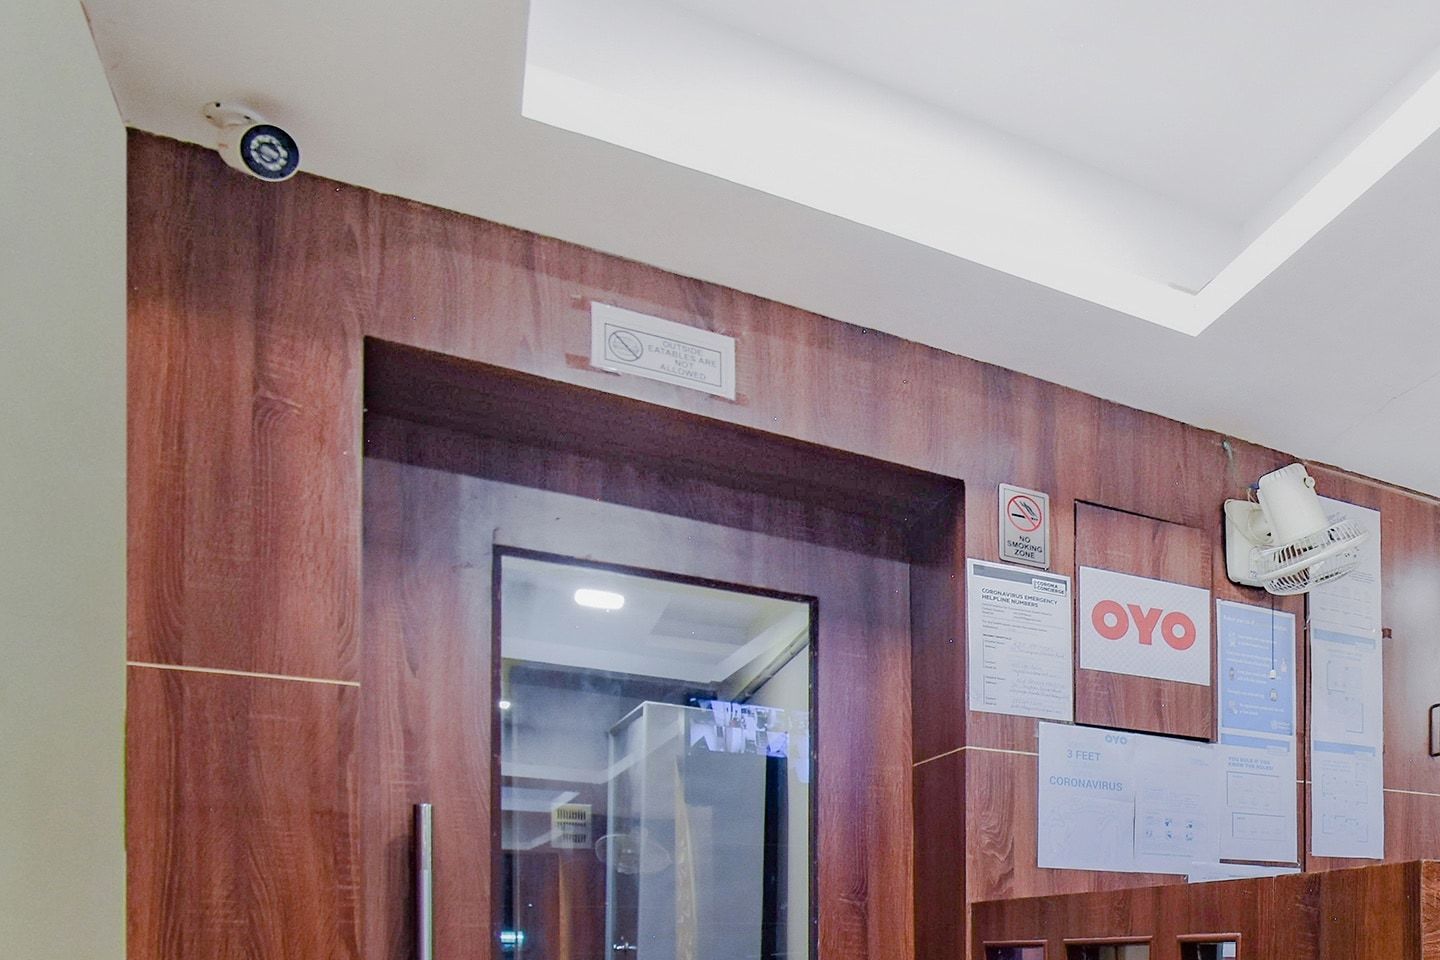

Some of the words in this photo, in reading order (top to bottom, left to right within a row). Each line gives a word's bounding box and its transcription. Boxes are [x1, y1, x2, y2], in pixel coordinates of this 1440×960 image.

[647, 344, 697, 362] EATABLES
[698, 357, 717, 368] ARE
[674, 359, 694, 369] NOT
[660, 363, 706, 380] ALLOWED
[1019, 535, 1031, 544] NO
[1007, 540, 1043, 553] SMOKING
[1014, 549, 1036, 559] ZONE
[981, 587, 1024, 600] CORONAVIRUS
[1023, 594, 1058, 605] EMERGENCY
[981, 594, 1011, 604] HELPLINE
[1010, 598, 1039, 608] NUMBERS
[1091, 600, 1196, 651] OYO
[1104, 734, 1128, 745] OYO
[1066, 749, 1073, 759] 3
[1075, 749, 1101, 761] FEET
[1049, 775, 1123, 792] CORONAVIRUS
